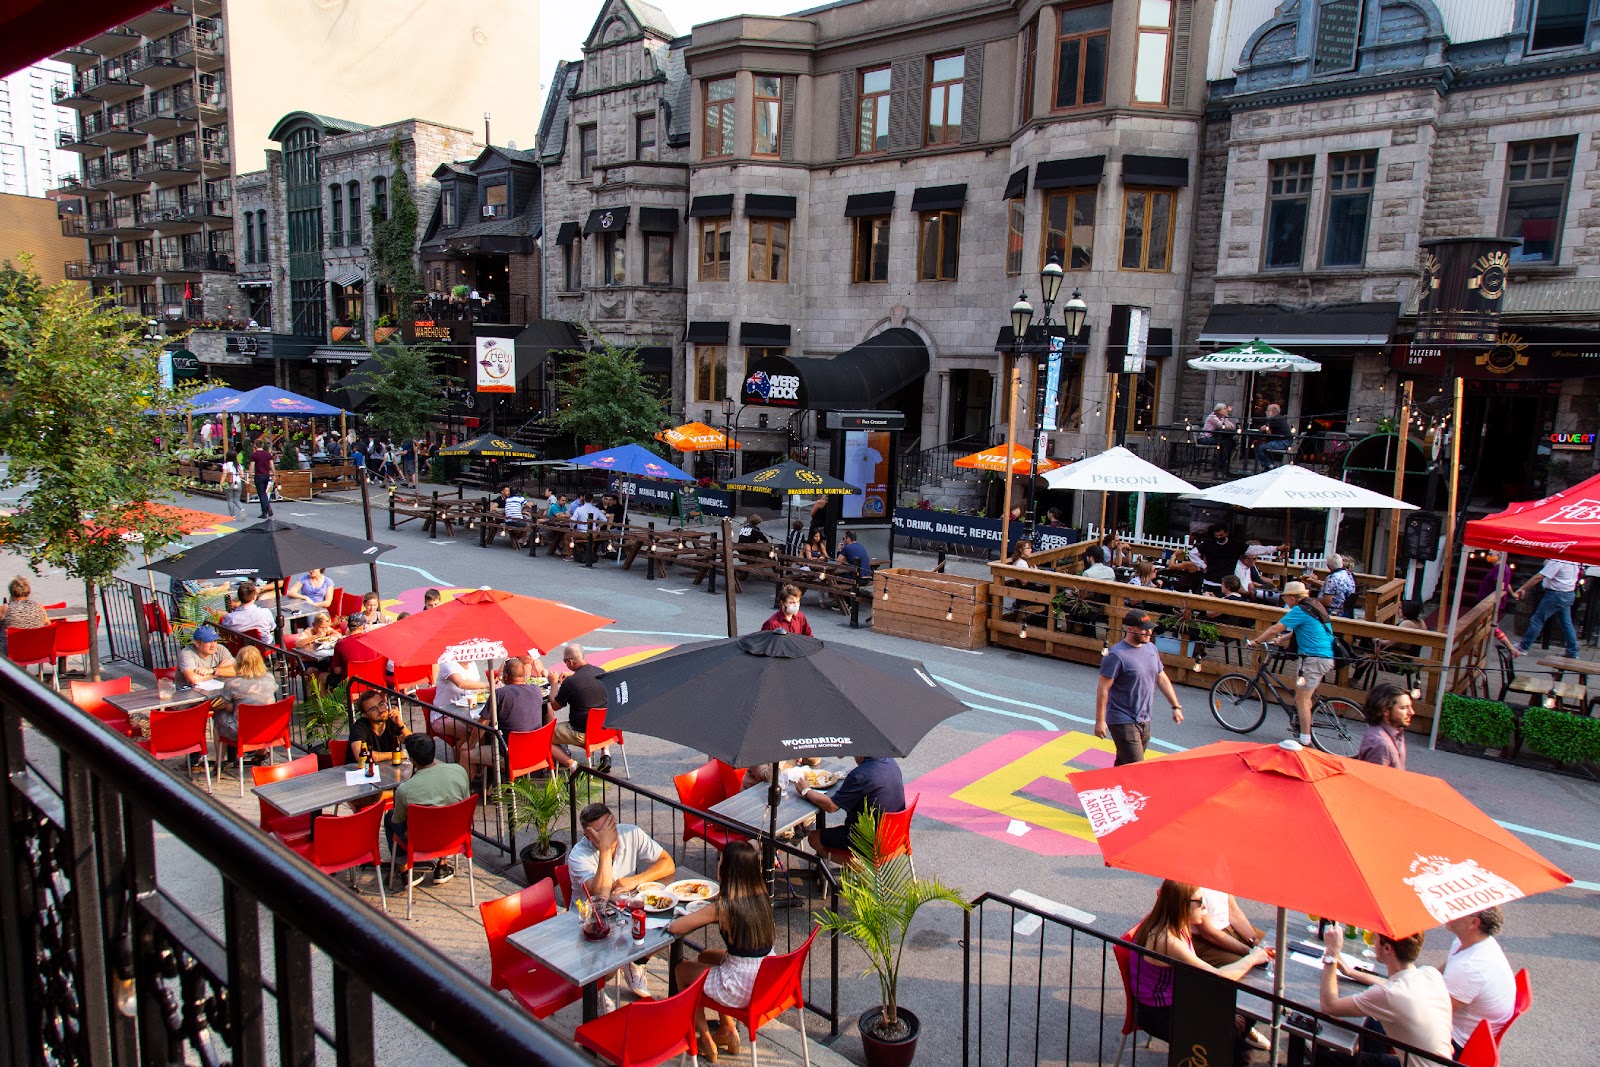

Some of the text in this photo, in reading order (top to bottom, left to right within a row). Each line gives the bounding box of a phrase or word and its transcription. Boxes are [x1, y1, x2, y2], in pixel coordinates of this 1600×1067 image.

[414, 326, 450, 338] WAREHOUSE
[1410, 349, 1441, 357] PIZZERIA
[1199, 355, 1287, 363] Heineken
[770, 375, 800, 388] AYERS
[769, 386, 799, 400] ROCK
[688, 434, 724, 444] VIZZY
[1550, 433, 1596, 443] OUVERT
[1091, 474, 1158, 485] PERONI
[1284, 490, 1358, 499] PERONI
[906, 519, 933, 532] DRINK,
[935, 522, 967, 538] DANCE,
[1041, 533, 1068, 545] AYERS
[453, 646, 495, 655] STELLA
[451, 653, 496, 661] ARTOIS
[781, 737, 854, 747] WOODBRIDGE
[1084, 798, 1108, 828] ARTOIS
[1099, 793, 1123, 823] STELLA
[1427, 873, 1488, 899] STELLA
[1445, 886, 1505, 914] ARTOIS
